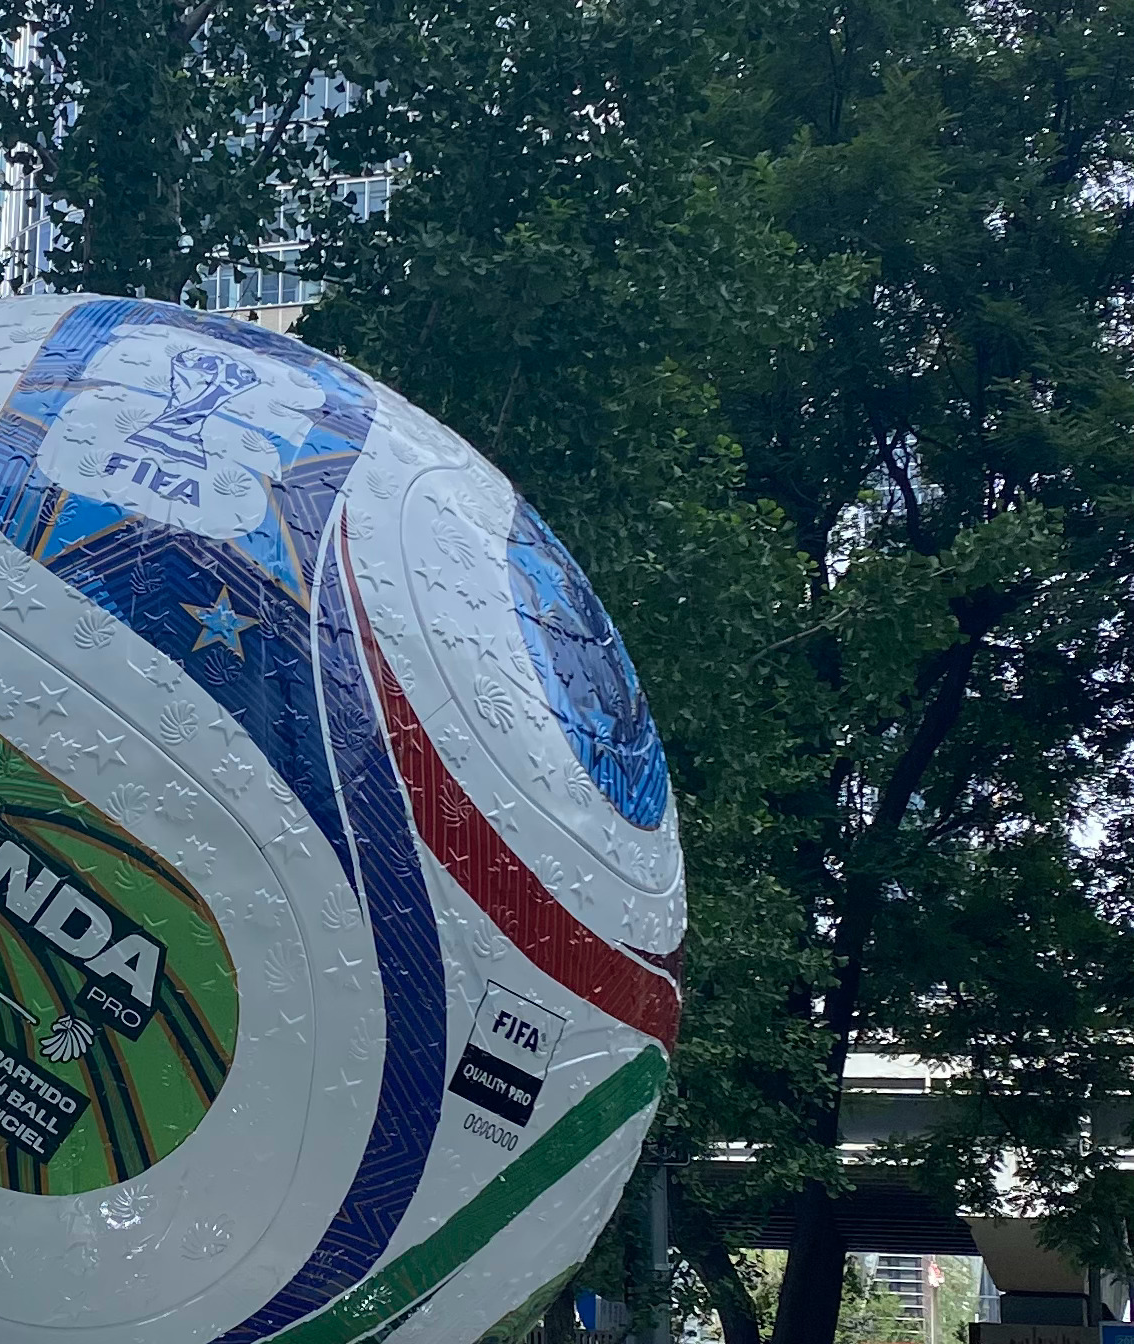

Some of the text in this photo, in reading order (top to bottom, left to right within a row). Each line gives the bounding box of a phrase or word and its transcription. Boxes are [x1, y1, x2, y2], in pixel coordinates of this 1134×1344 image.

[104, 452, 201, 508] FIFA
[85, 985, 143, 1029] PRO
[492, 1010, 540, 1053] FIFA
[463, 1063, 532, 1106] QUALITY PRO
[6, 1089, 59, 1136] BALL
